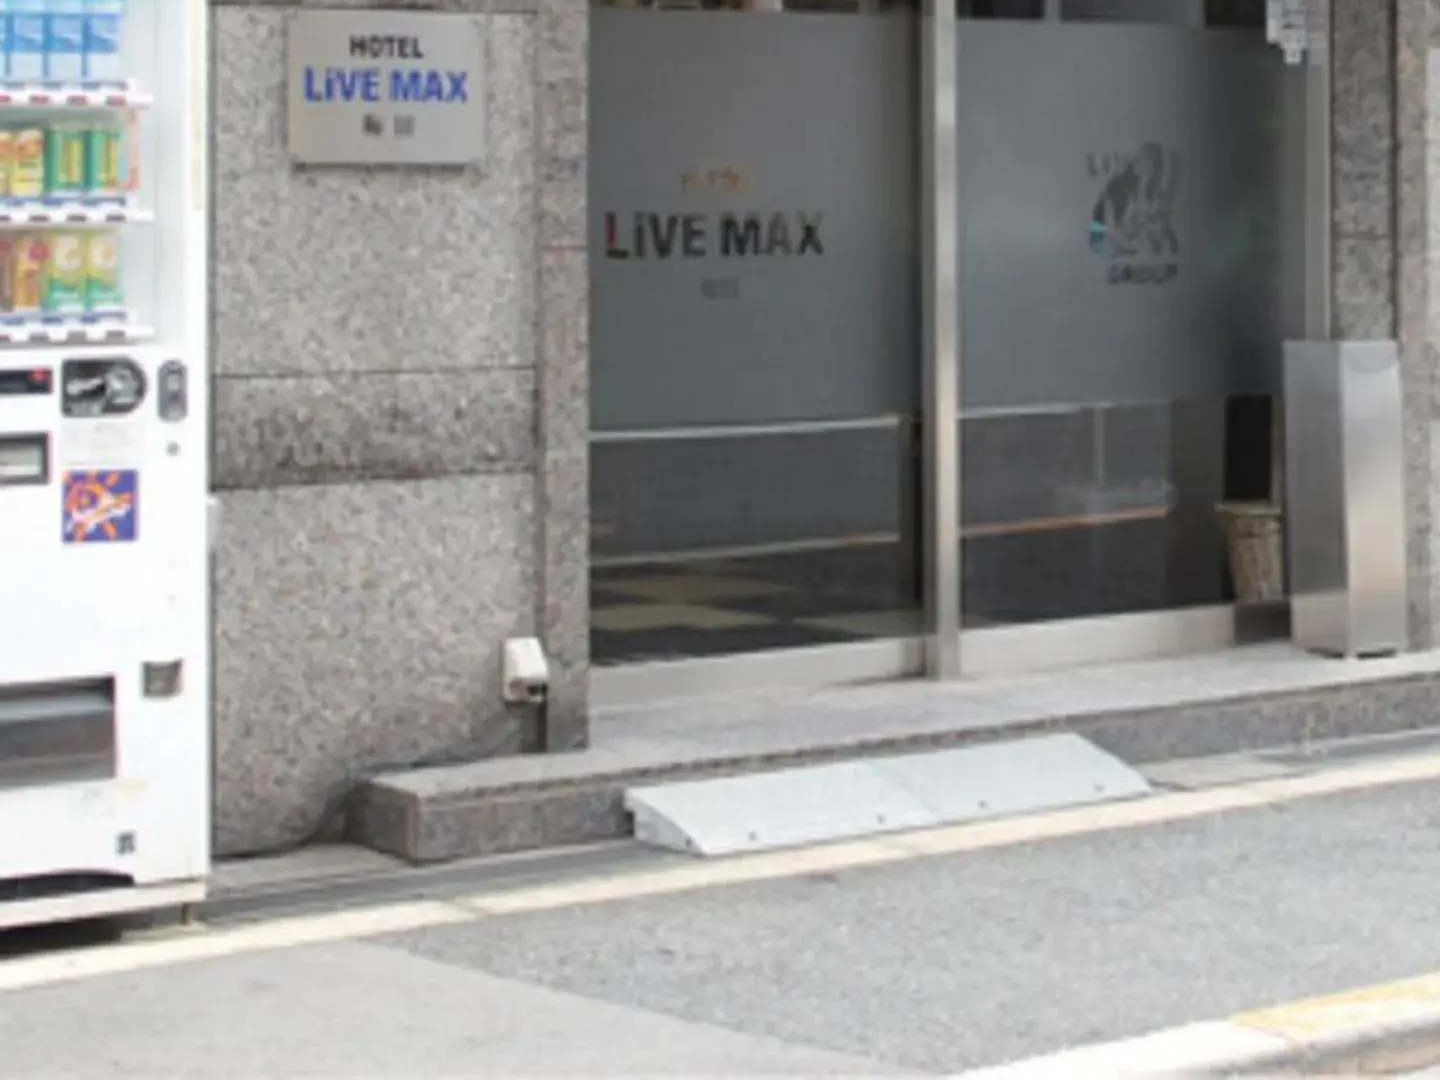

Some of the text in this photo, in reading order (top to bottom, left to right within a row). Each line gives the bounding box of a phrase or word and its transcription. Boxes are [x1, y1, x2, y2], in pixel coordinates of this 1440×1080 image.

[349, 34, 425, 60] HOTEL
[389, 69, 468, 103] MAX
[718, 210, 825, 257] MAX
